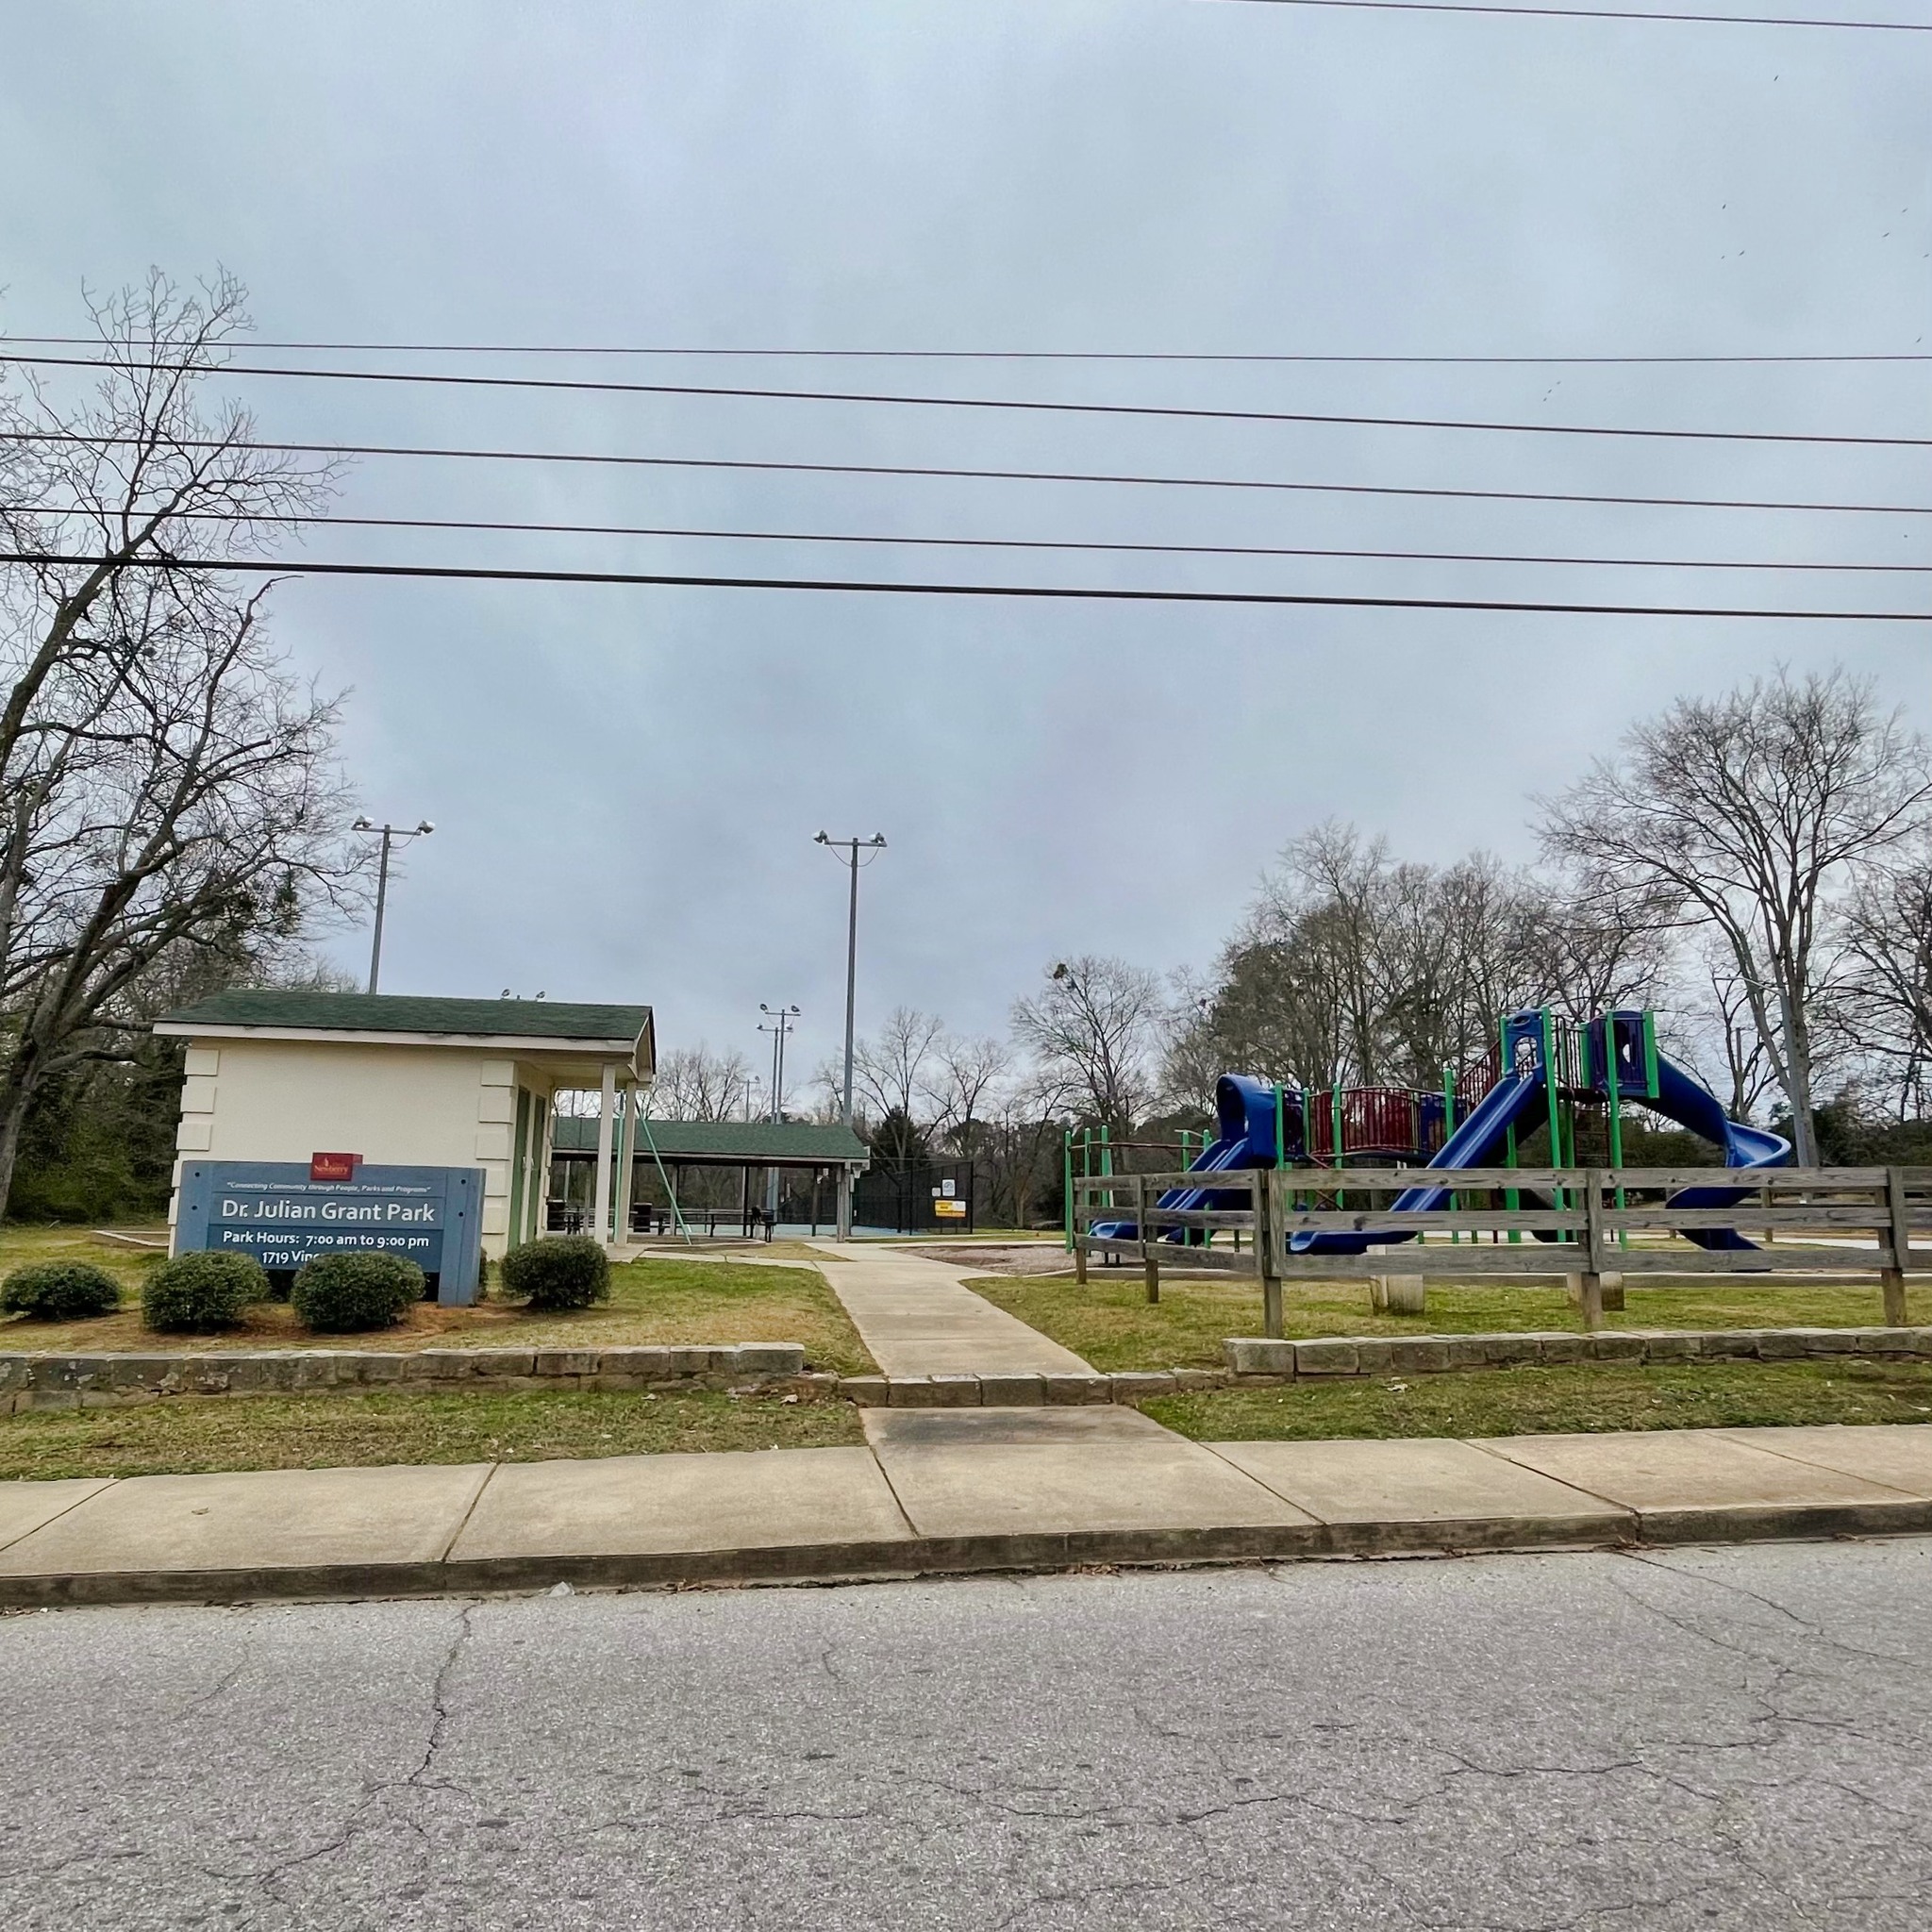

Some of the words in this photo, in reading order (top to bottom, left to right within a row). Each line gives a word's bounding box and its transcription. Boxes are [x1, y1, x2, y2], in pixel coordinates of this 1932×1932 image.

[269, 1183, 308, 1191] Community
[222, 1199, 248, 1218] Dr.
[254, 1200, 316, 1219] Julian
[321, 1202, 382, 1221] Grant
[387, 1203, 435, 1222] Park
[223, 1230, 254, 1242] Park
[257, 1231, 300, 1244] Hours:
[306, 1235, 334, 1247] 7:00
[336, 1236, 358, 1245] am
[359, 1235, 375, 1245] to
[376, 1237, 406, 1248] 9:00
[408, 1238, 430, 1250] pm
[262, 1251, 290, 1264] 1719
[291, 1250, 320, 1262] Vin
